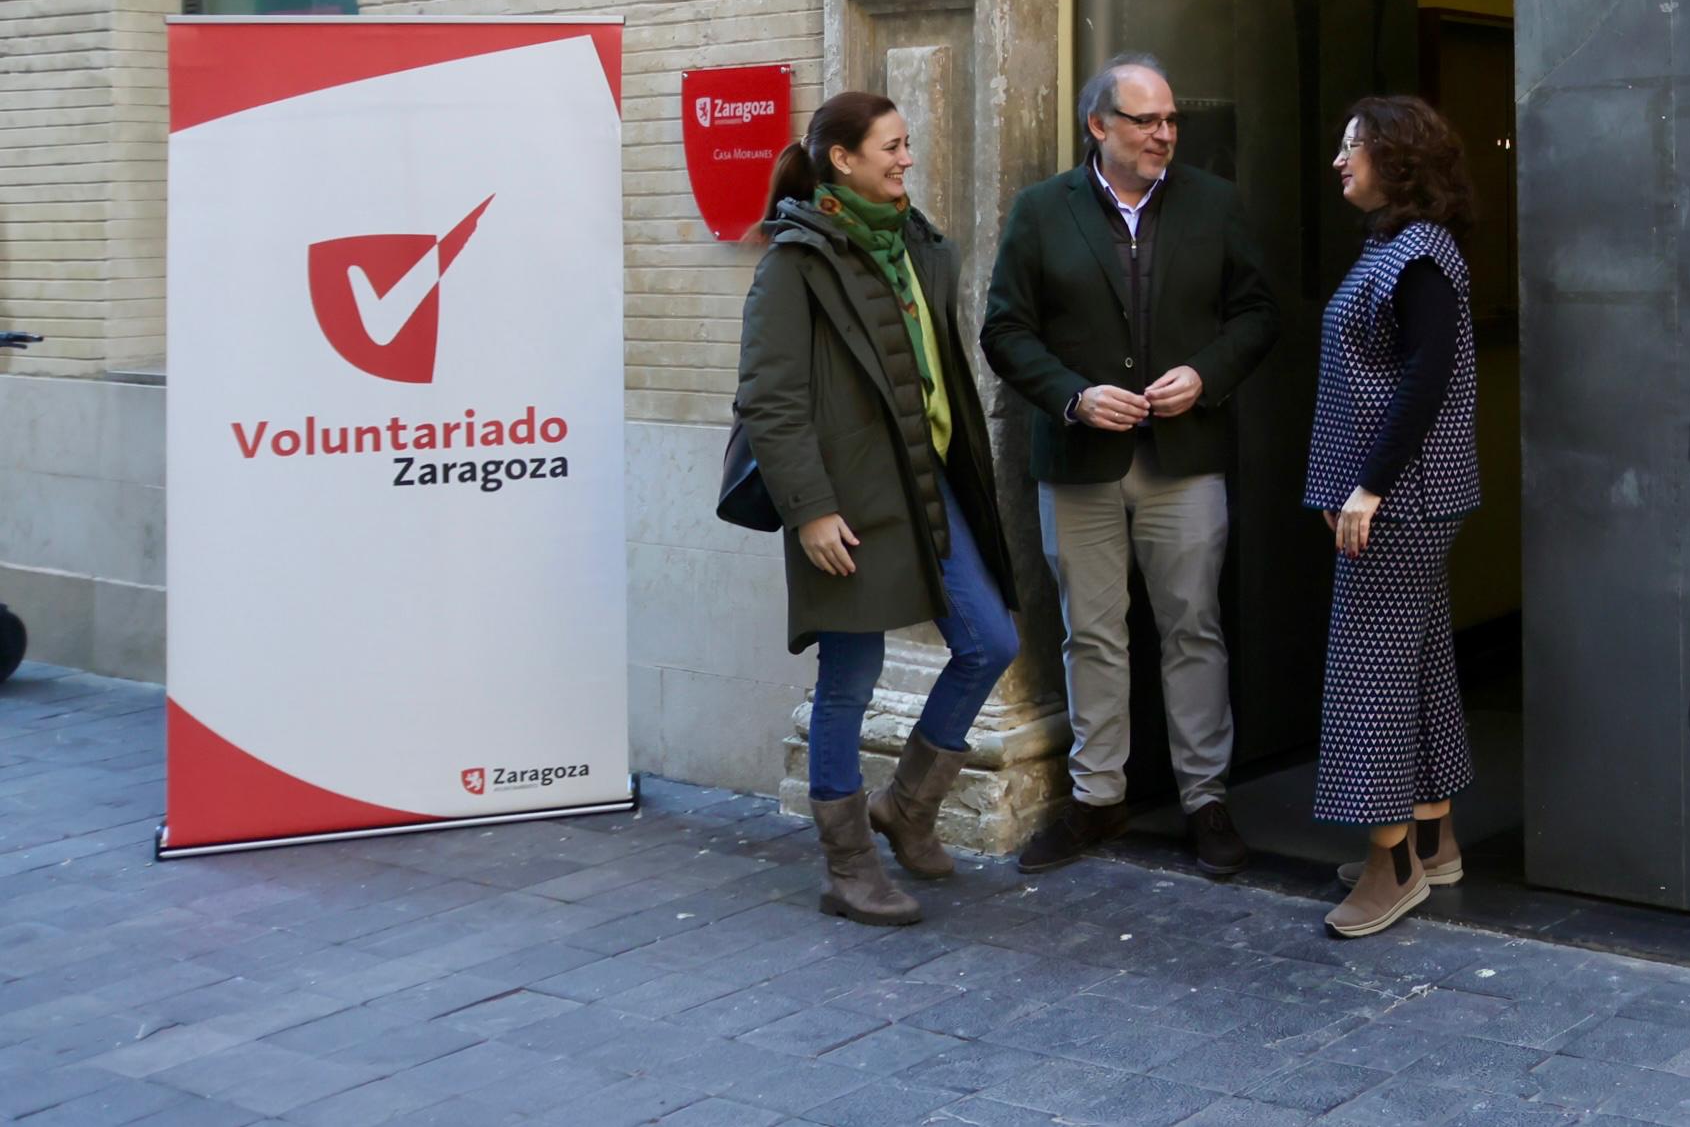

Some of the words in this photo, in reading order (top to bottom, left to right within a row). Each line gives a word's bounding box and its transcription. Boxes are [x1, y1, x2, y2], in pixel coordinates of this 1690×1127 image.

[714, 98, 775, 123] Zaragoza
[231, 406, 569, 458] Voluntariado
[392, 455, 569, 492] Zaragoza
[493, 763, 590, 786] Zaragoza
